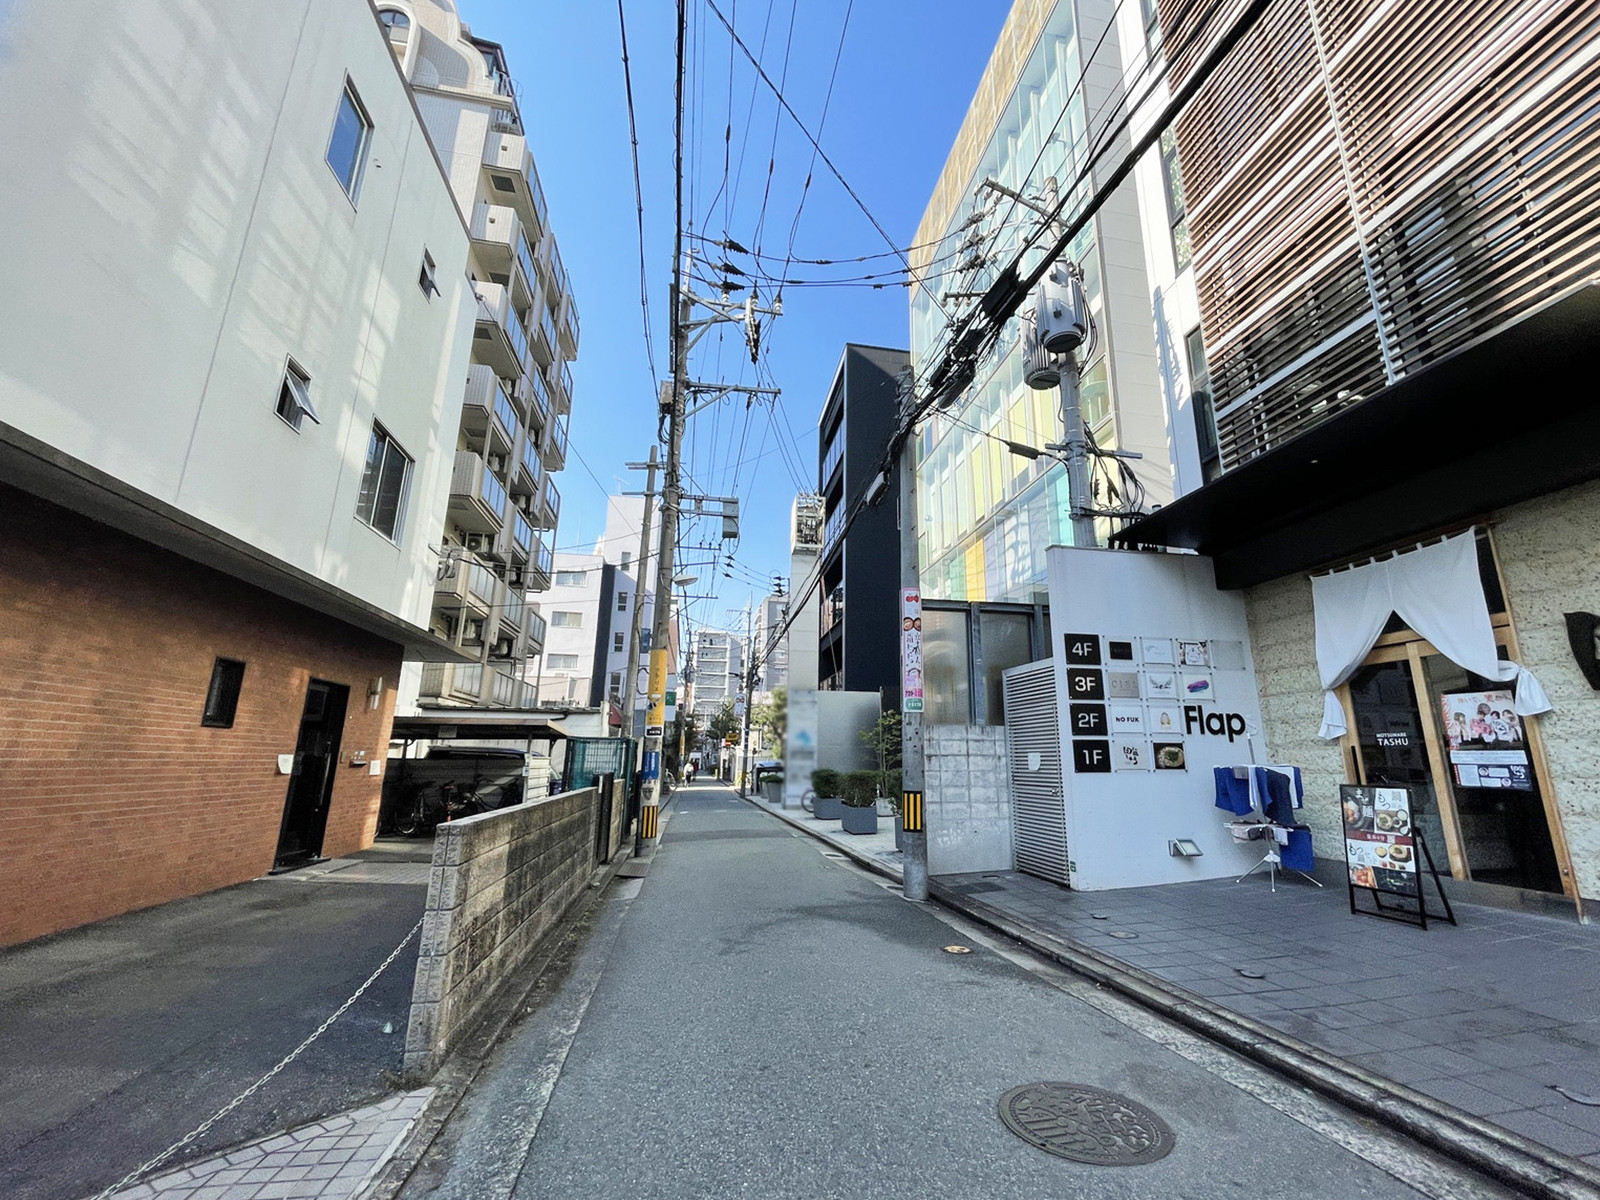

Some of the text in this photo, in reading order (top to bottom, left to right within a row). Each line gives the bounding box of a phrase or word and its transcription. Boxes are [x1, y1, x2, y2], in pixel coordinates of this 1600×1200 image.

[1072, 642, 1092, 656] 4F
[1075, 677, 1096, 691] 3F
[1078, 713, 1099, 727] 2F
[1183, 705, 1246, 743] Flap
[1377, 738, 1409, 746] TASHU
[1083, 750, 1103, 765] 1F
